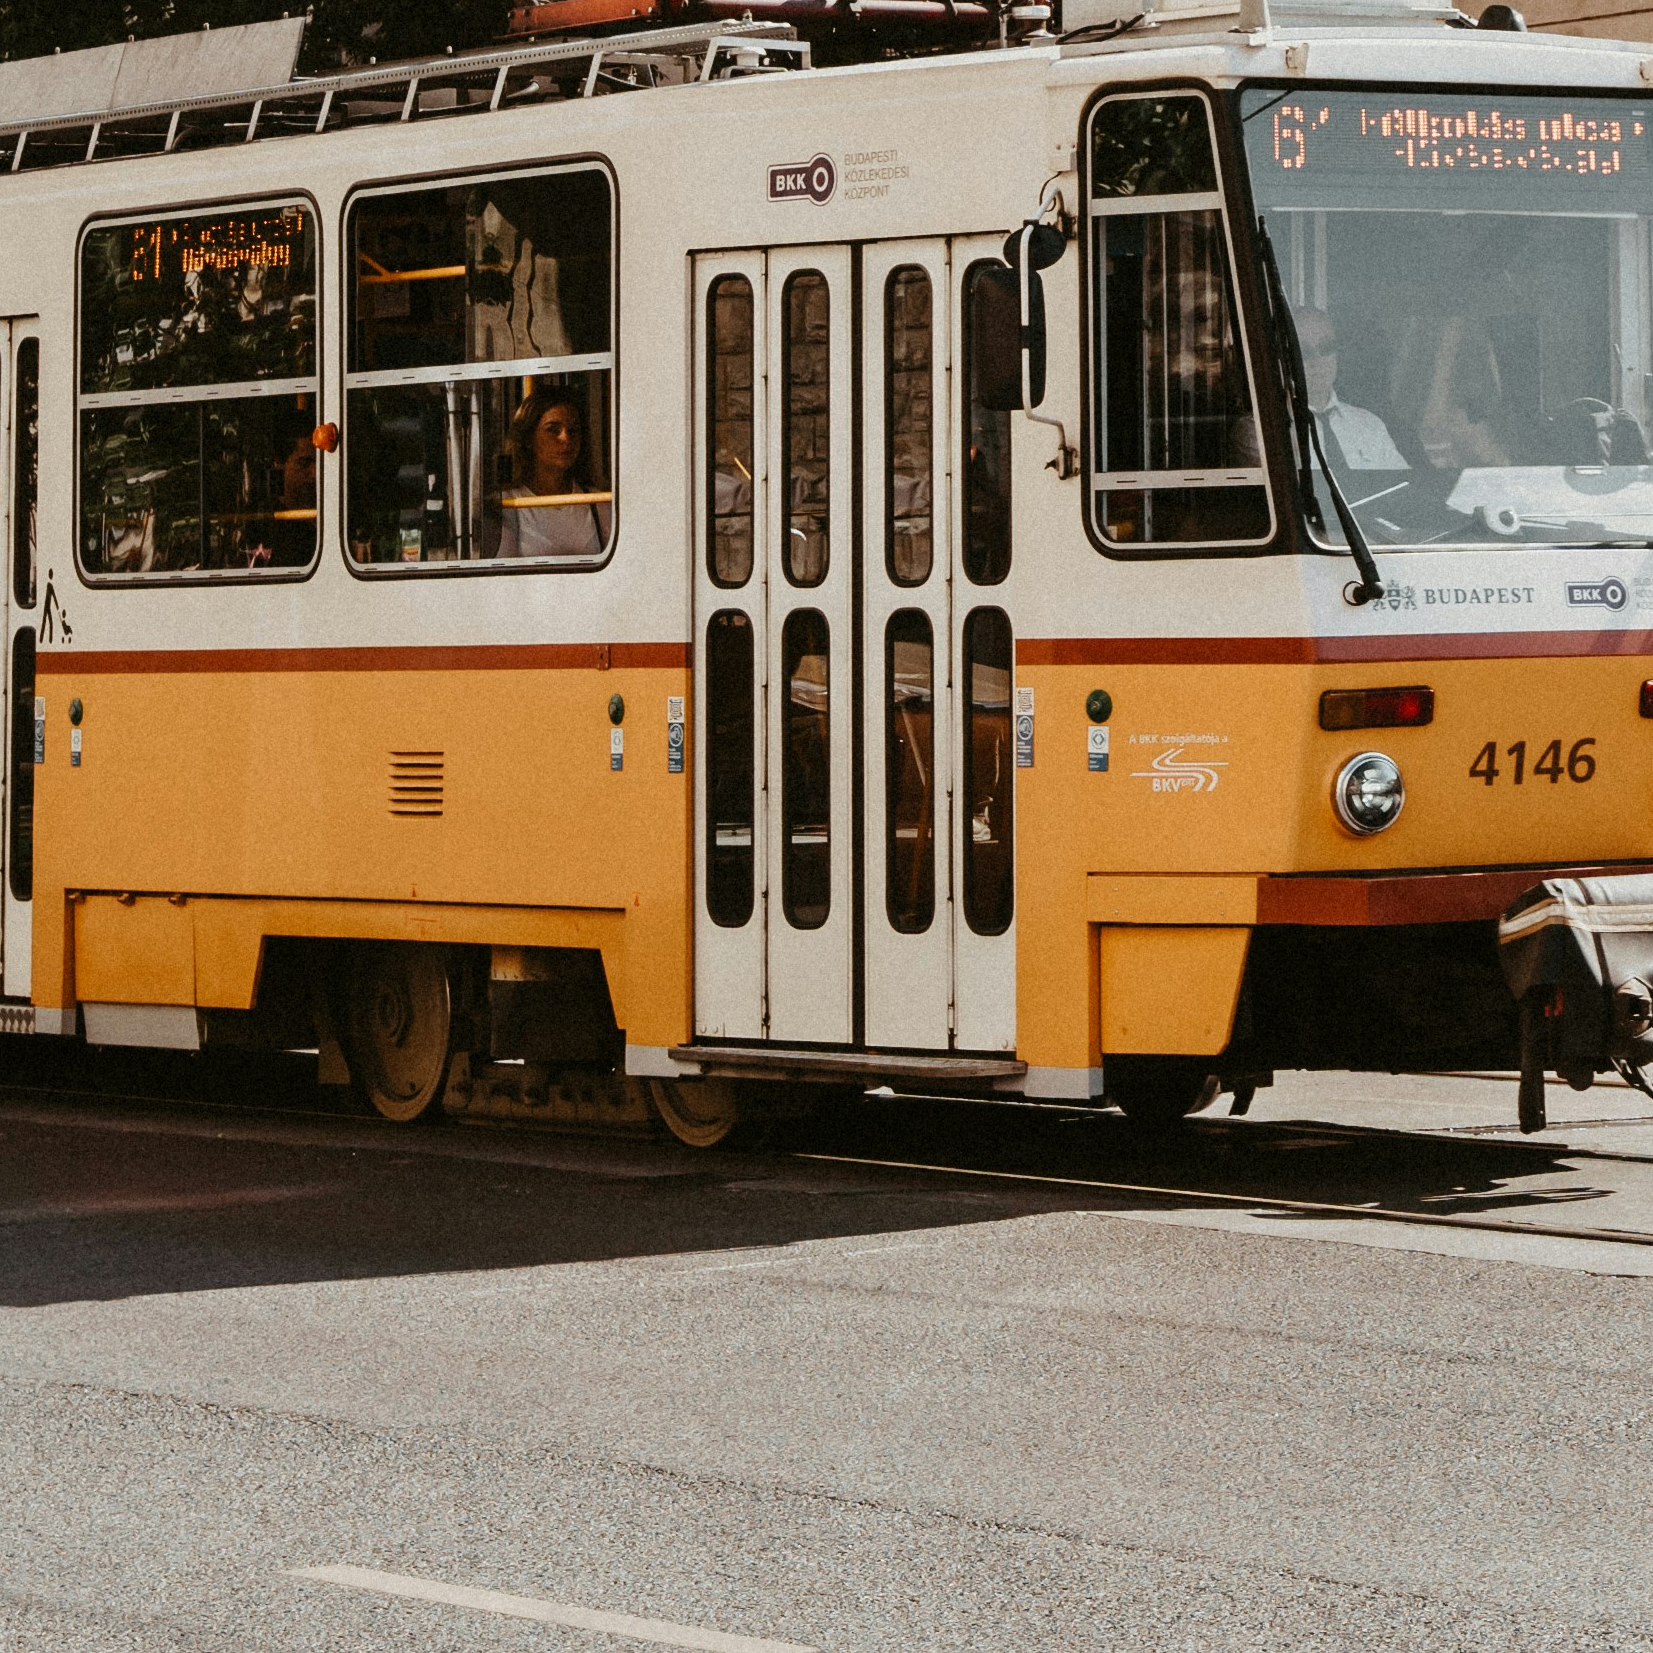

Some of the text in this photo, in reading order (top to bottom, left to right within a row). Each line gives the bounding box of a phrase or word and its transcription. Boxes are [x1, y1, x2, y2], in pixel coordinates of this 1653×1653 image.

[776, 173, 807, 192] BKK
[1423, 586, 1535, 605] BUDAPEST
[1573, 588, 1602, 601] BKK
[1129, 734, 1137, 745] A
[1469, 738, 1597, 785] 4146
[1152, 778, 1181, 793] BKV
